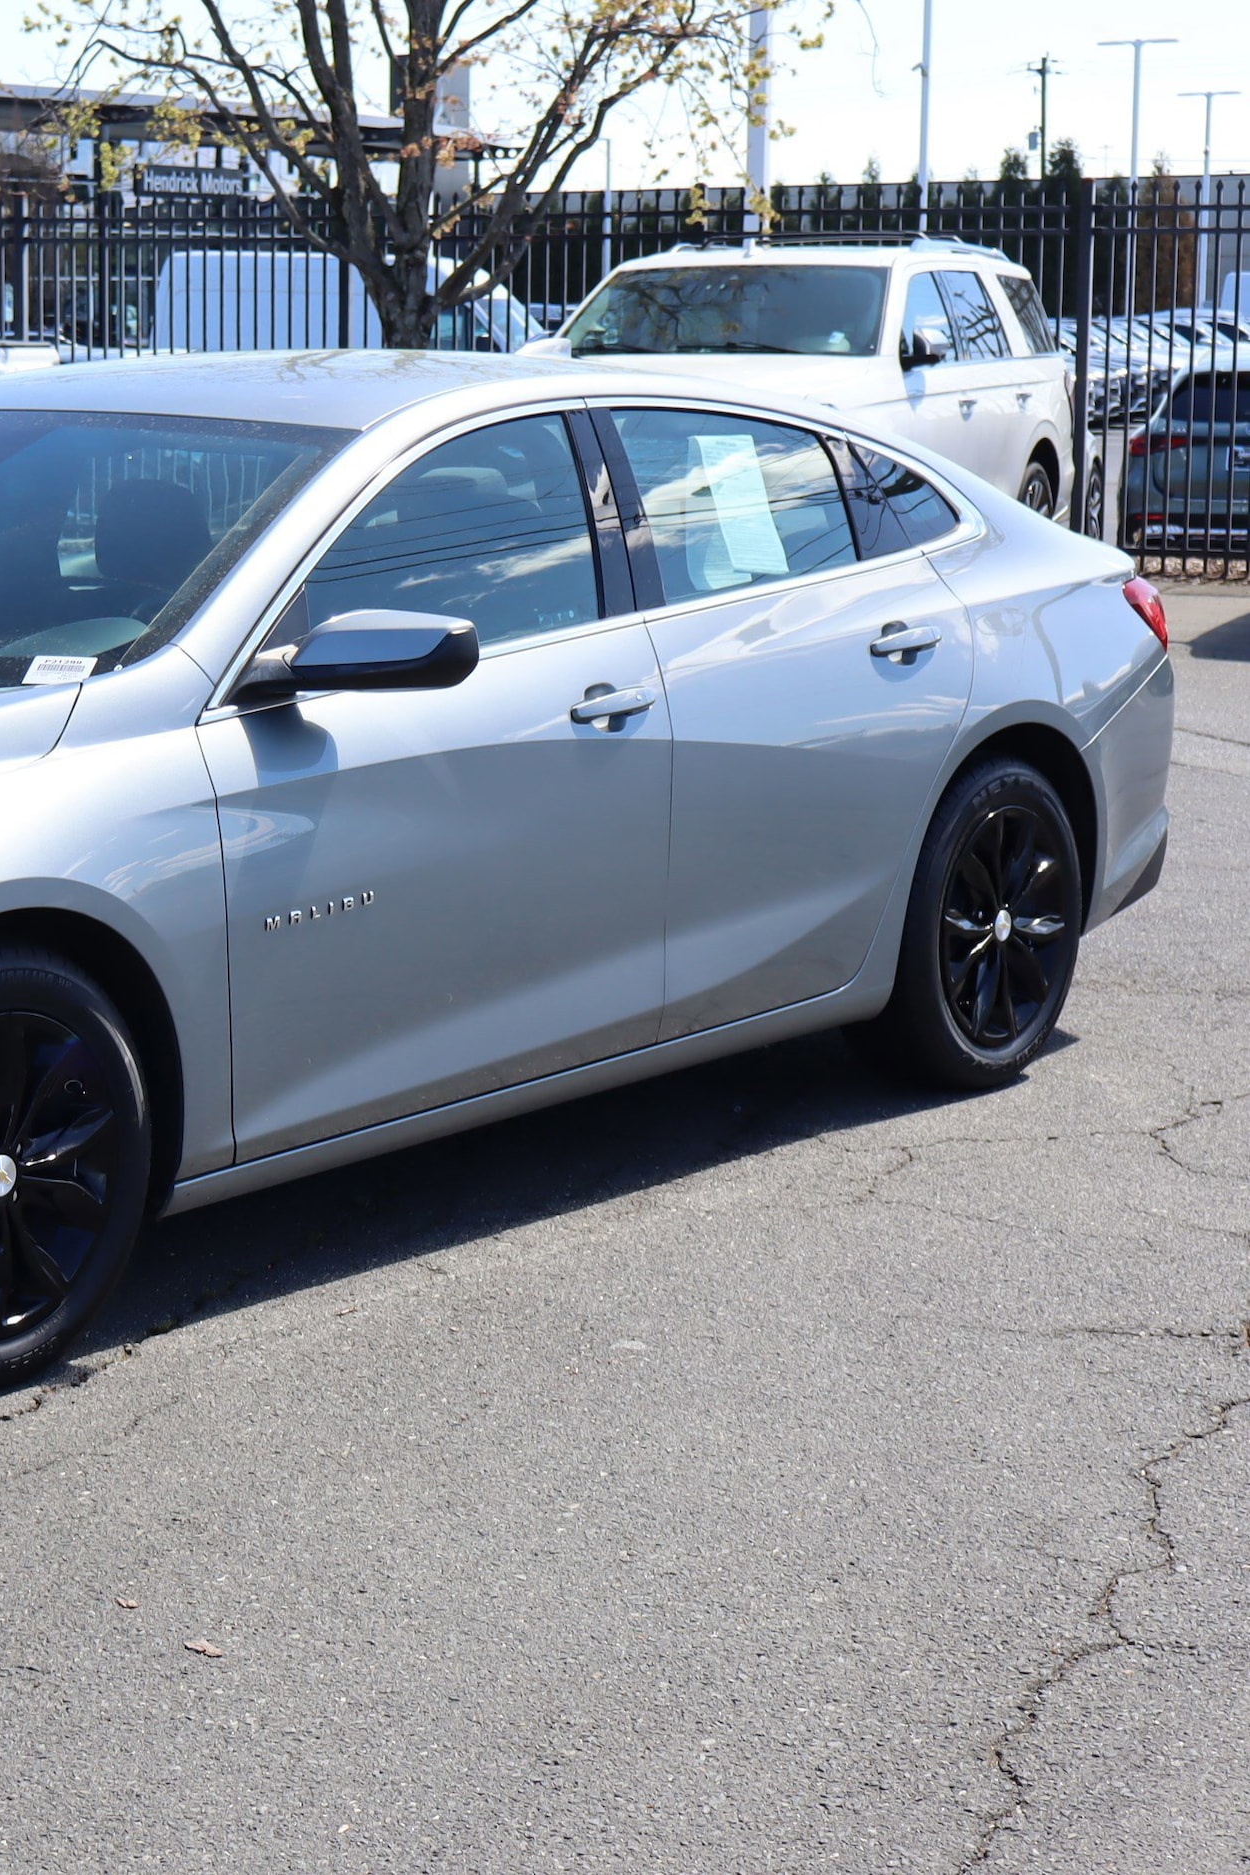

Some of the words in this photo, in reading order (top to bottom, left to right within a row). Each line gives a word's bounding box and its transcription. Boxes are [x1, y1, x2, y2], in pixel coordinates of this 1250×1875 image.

[143, 169, 199, 193] Hendrick
[201, 172, 243, 195] Motors
[264, 890, 375, 932] MALIBU
